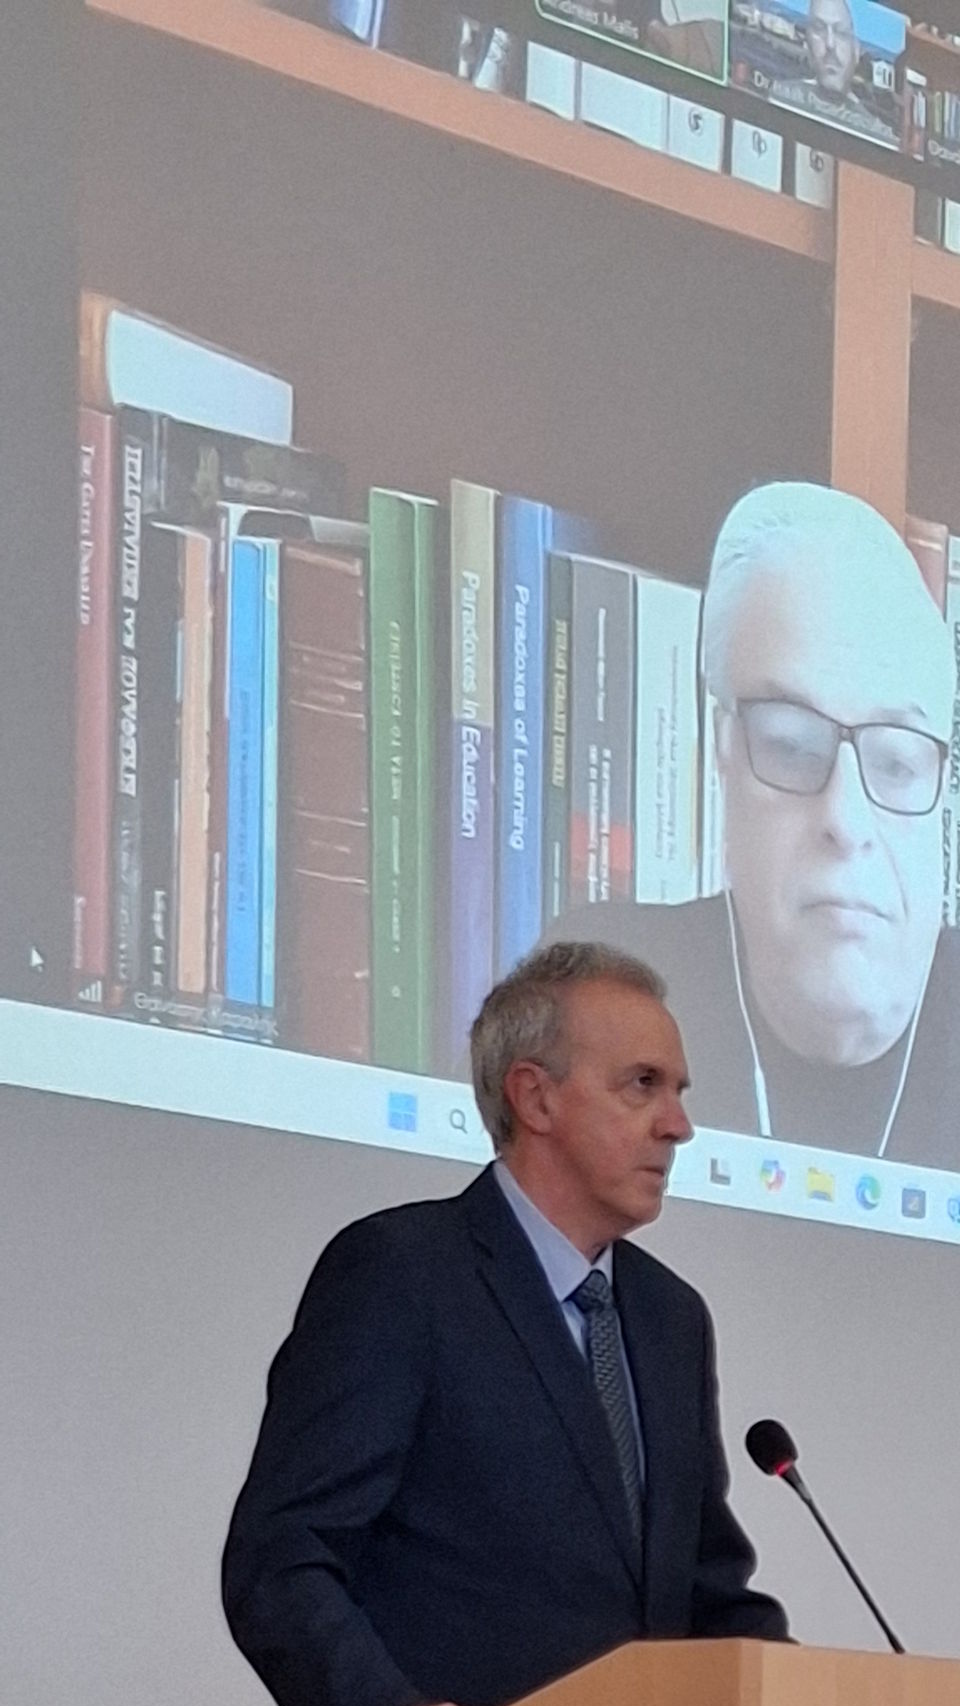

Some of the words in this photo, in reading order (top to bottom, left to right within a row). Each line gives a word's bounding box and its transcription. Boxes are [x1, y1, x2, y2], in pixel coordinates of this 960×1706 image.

[461, 568, 480, 692] Paradoxes
[512, 584, 531, 716] Paradoxes
[461, 726, 481, 839] Education
[510, 719, 529, 744] of
[507, 746, 529, 851] Learning
